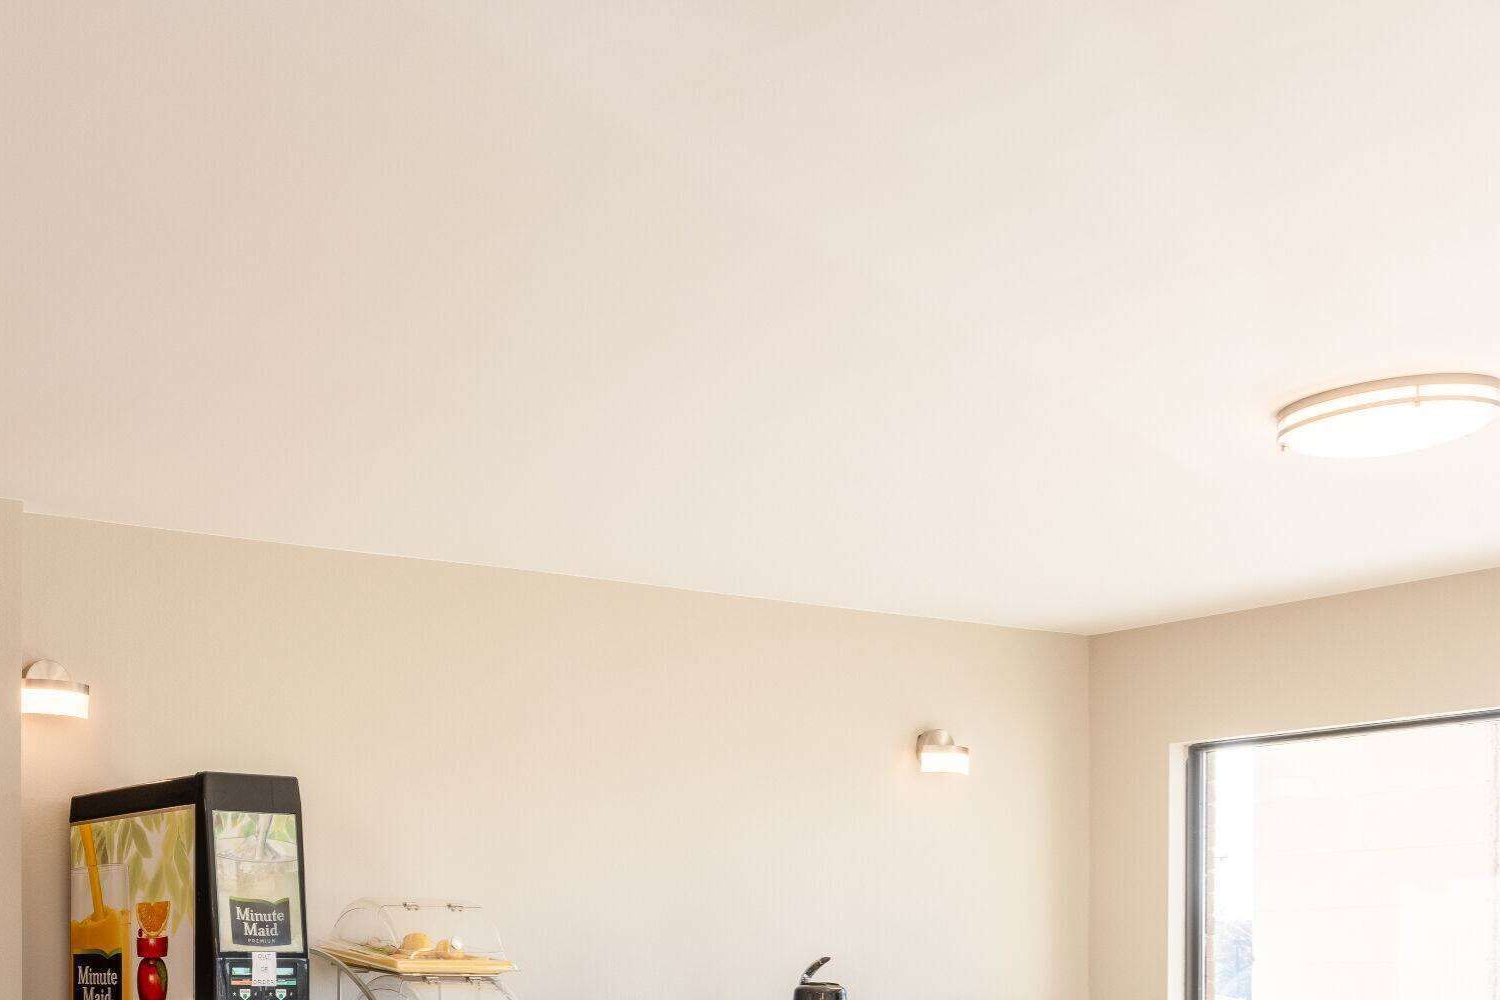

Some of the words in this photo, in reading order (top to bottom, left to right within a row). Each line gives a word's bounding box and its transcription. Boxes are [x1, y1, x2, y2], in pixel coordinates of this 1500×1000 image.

[235, 906, 285, 922] Minute
[242, 921, 279, 937] Maid
[77, 965, 118, 986] Minute
